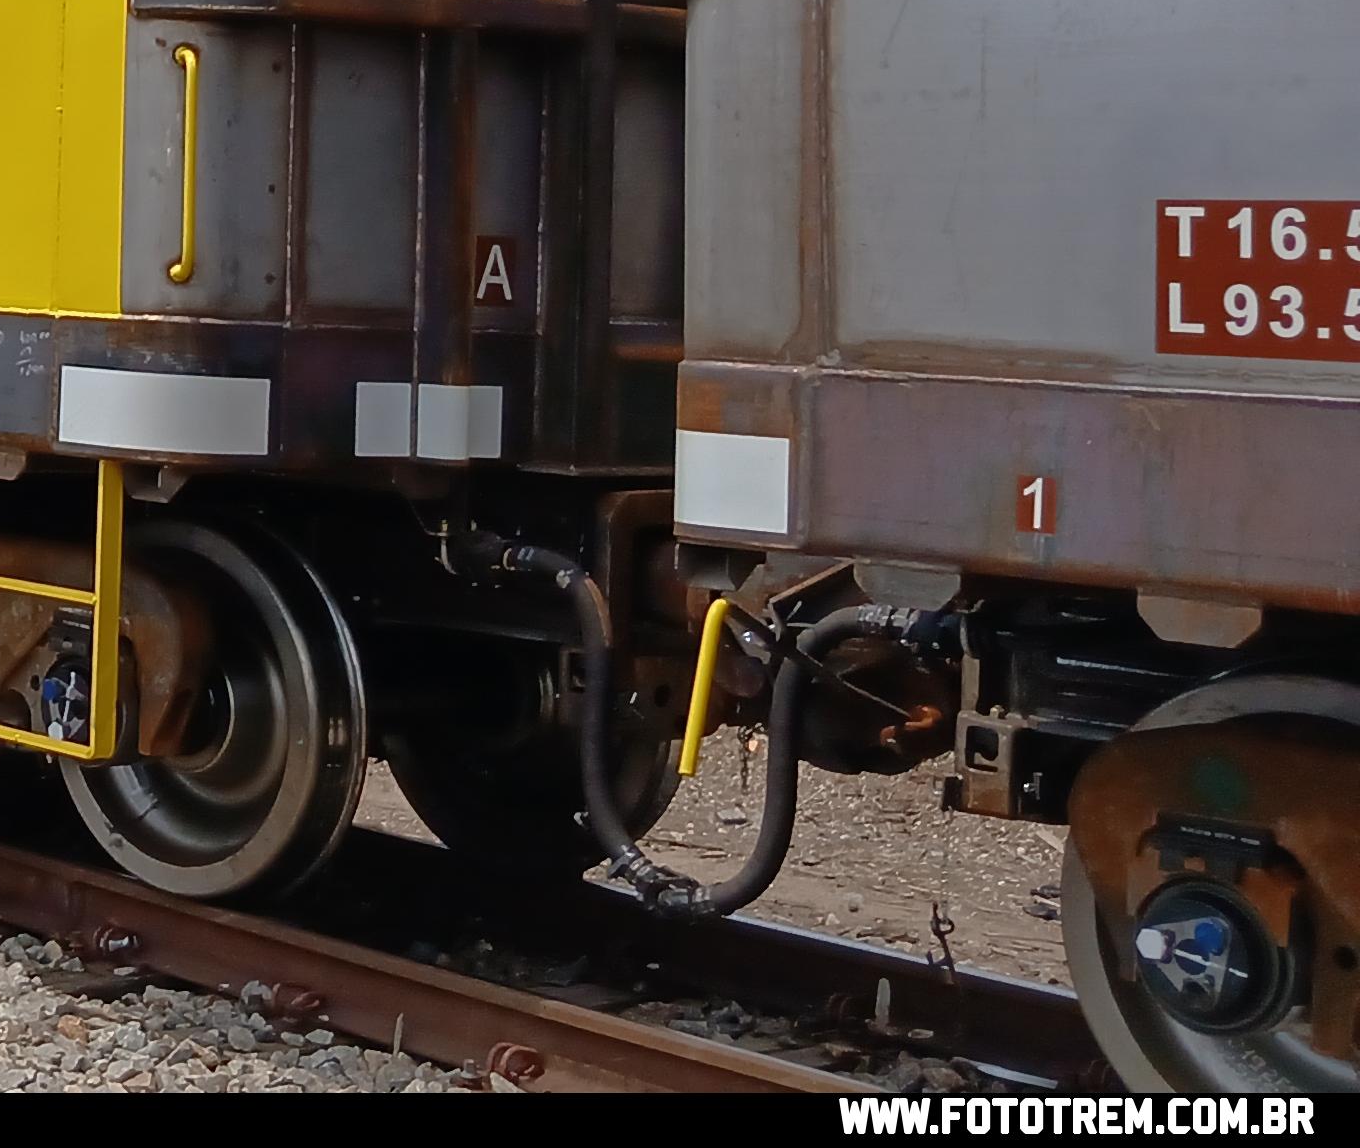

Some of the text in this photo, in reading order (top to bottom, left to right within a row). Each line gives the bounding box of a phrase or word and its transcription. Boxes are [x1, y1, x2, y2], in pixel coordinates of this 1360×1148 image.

[1165, 206, 1206, 258] T
[476, 243, 513, 301] A
[1168, 282, 1206, 334] L
[1023, 477, 1043, 529] 1
